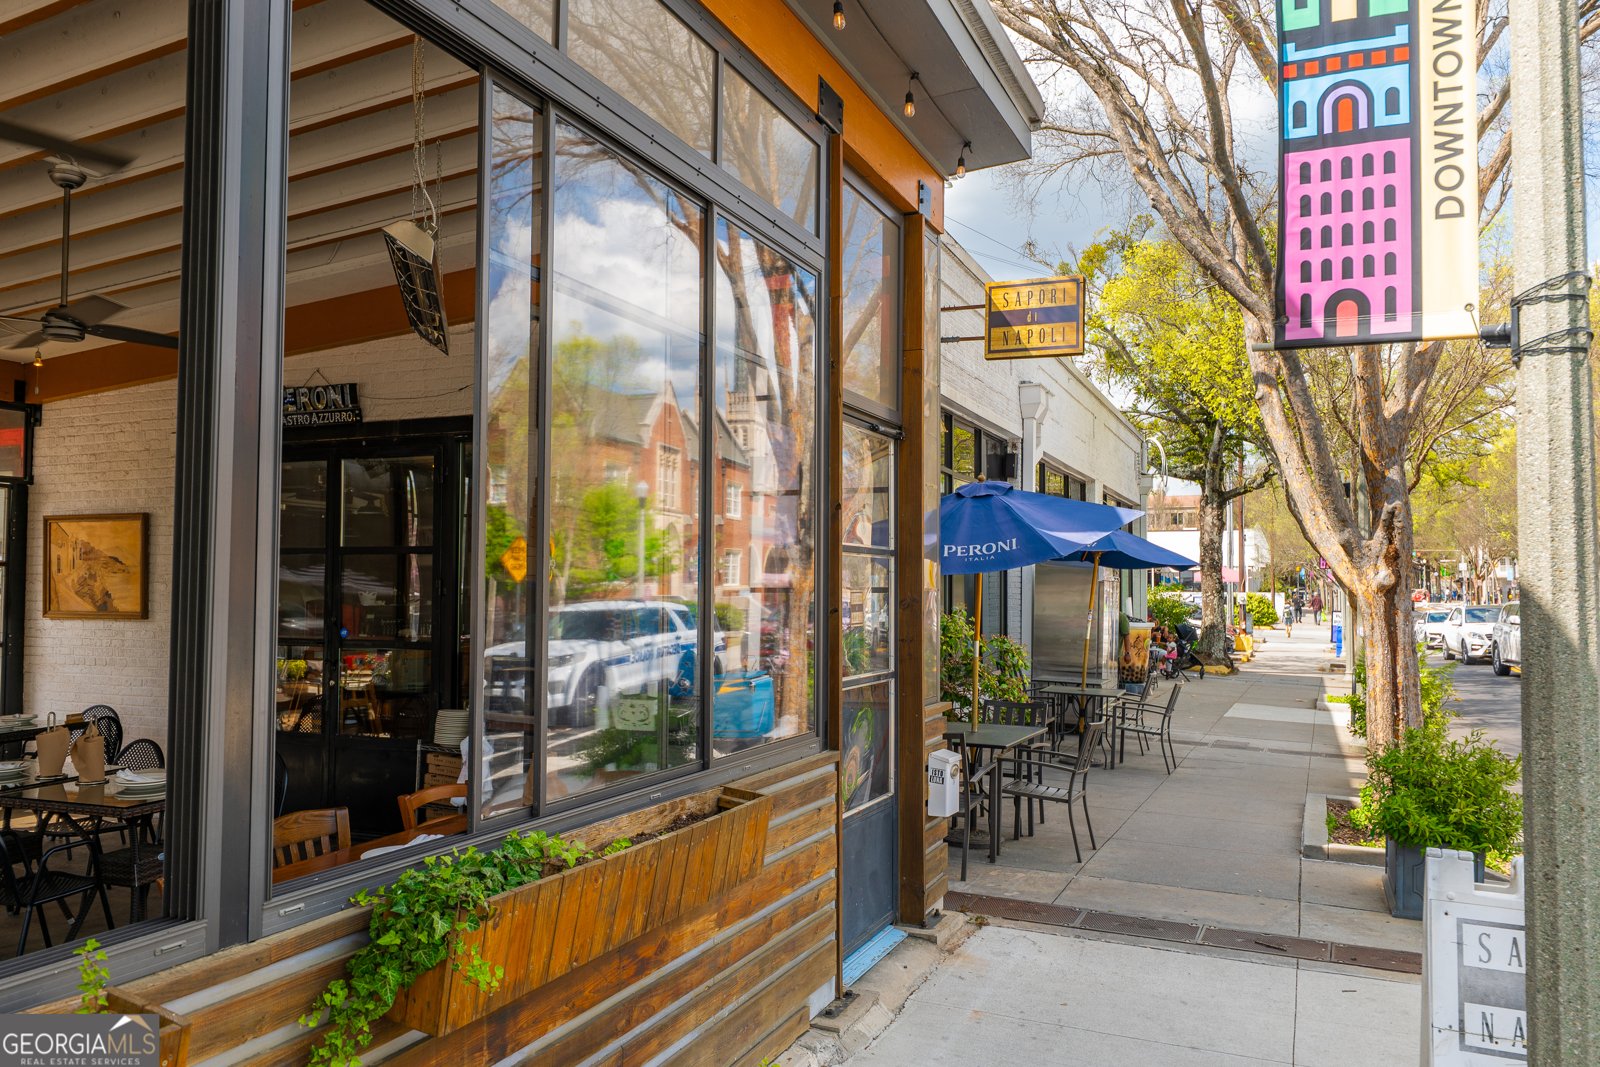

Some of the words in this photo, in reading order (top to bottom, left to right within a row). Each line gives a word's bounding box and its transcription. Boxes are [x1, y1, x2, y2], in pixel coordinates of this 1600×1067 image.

[1003, 288, 1066, 308] SAPORI
[1027, 311, 1038, 323] di
[1003, 326, 1066, 347] NAPOLI
[943, 537, 1018, 557] PERONI
